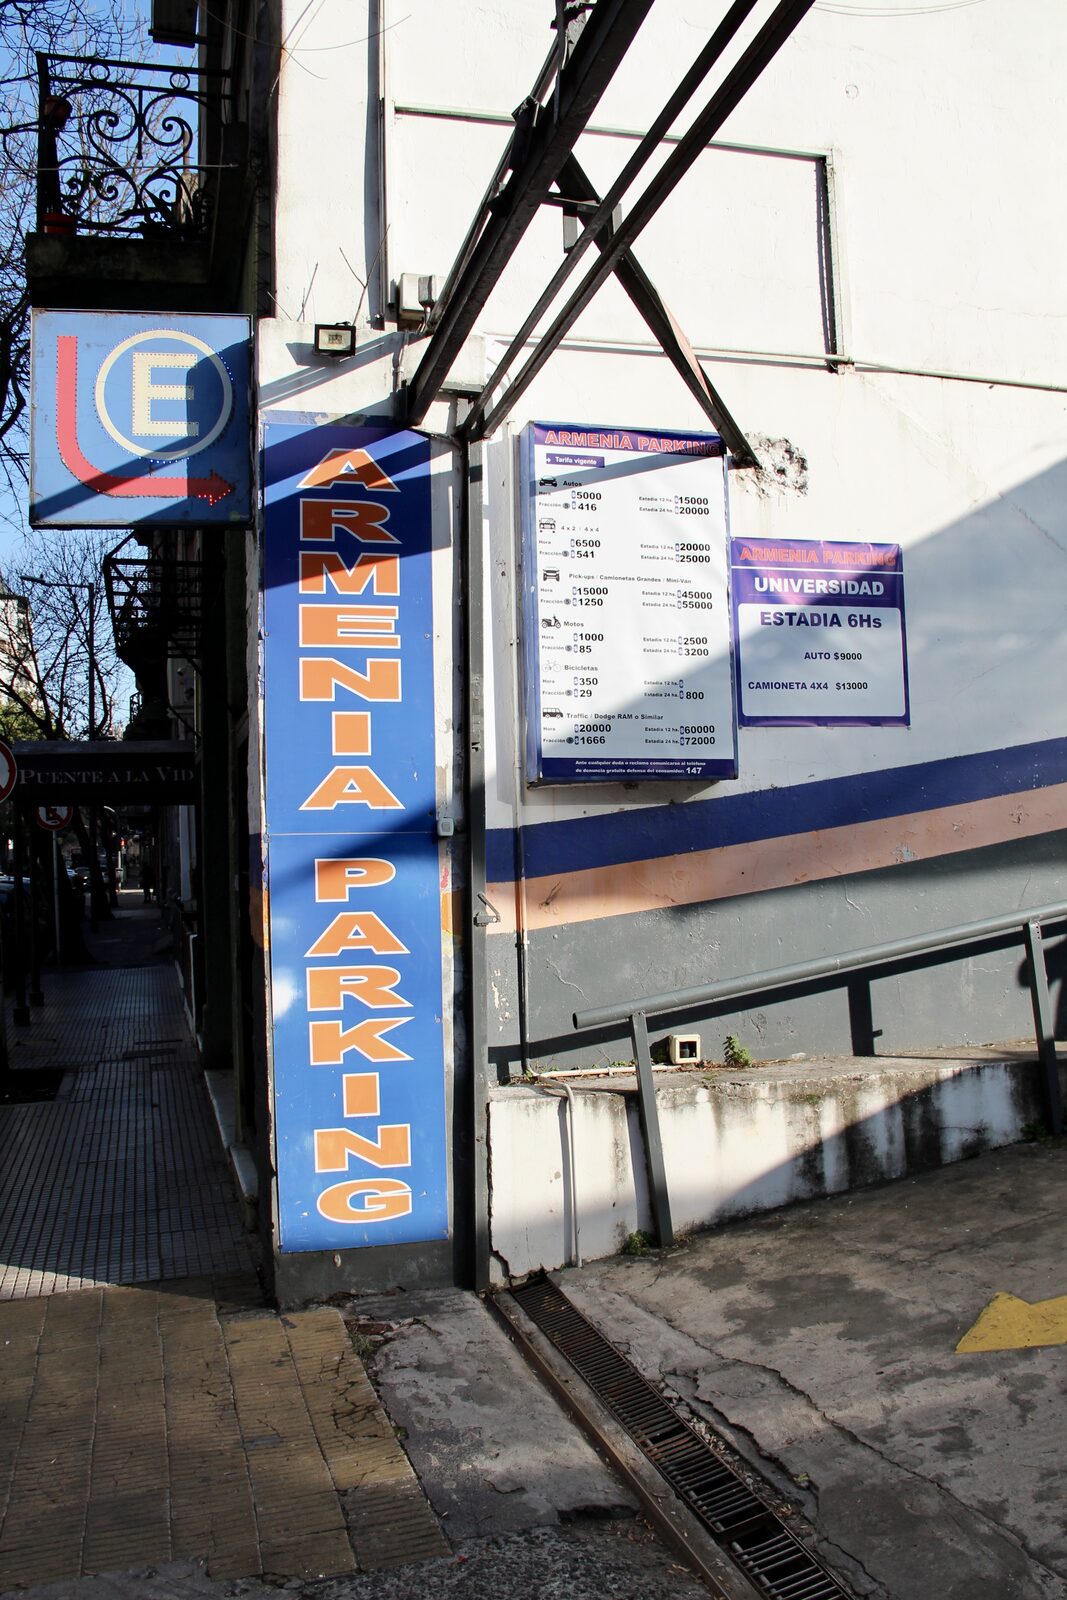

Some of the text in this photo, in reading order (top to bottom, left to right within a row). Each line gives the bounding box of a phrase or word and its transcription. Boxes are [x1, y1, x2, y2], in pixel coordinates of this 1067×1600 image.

[131, 352, 199, 436] E
[545, 430, 720, 456] ARMENIA PARKING
[555, 456, 573, 464] Tarifa
[576, 491, 602, 500] 5000
[678, 496, 709, 505] 15000
[578, 503, 597, 511] 416
[679, 506, 710, 515] 20000
[575, 539, 601, 548] 6500
[680, 543, 711, 552] 20000
[576, 550, 595, 558] 541
[680, 554, 711, 563] 25000
[740, 546, 896, 567] ARMENIA PARKING
[754, 576, 884, 596] UNIVERSIDAD
[577, 587, 609, 595] 15000
[682, 591, 712, 600] 45000
[578, 598, 603, 606] 1250
[682, 601, 713, 610] 55000
[760, 611, 882, 629] ESTADIA 6Hs
[579, 633, 604, 642] 1000
[683, 637, 708, 645] 2500
[579, 645, 592, 654] 85
[684, 648, 709, 656] 3200
[804, 652, 862, 661] AUTO $9000
[579, 677, 599, 686] 350
[748, 682, 868, 691] CAMIONETA 4X4 $13000
[579, 689, 592, 698] 29
[685, 691, 704, 700] 800
[579, 724, 612, 733] 20000
[684, 725, 715, 734] 60000
[580, 736, 606, 745] 1666
[685, 737, 715, 745] 72000
[296, 447, 415, 1223] ARMENIA PARKING
